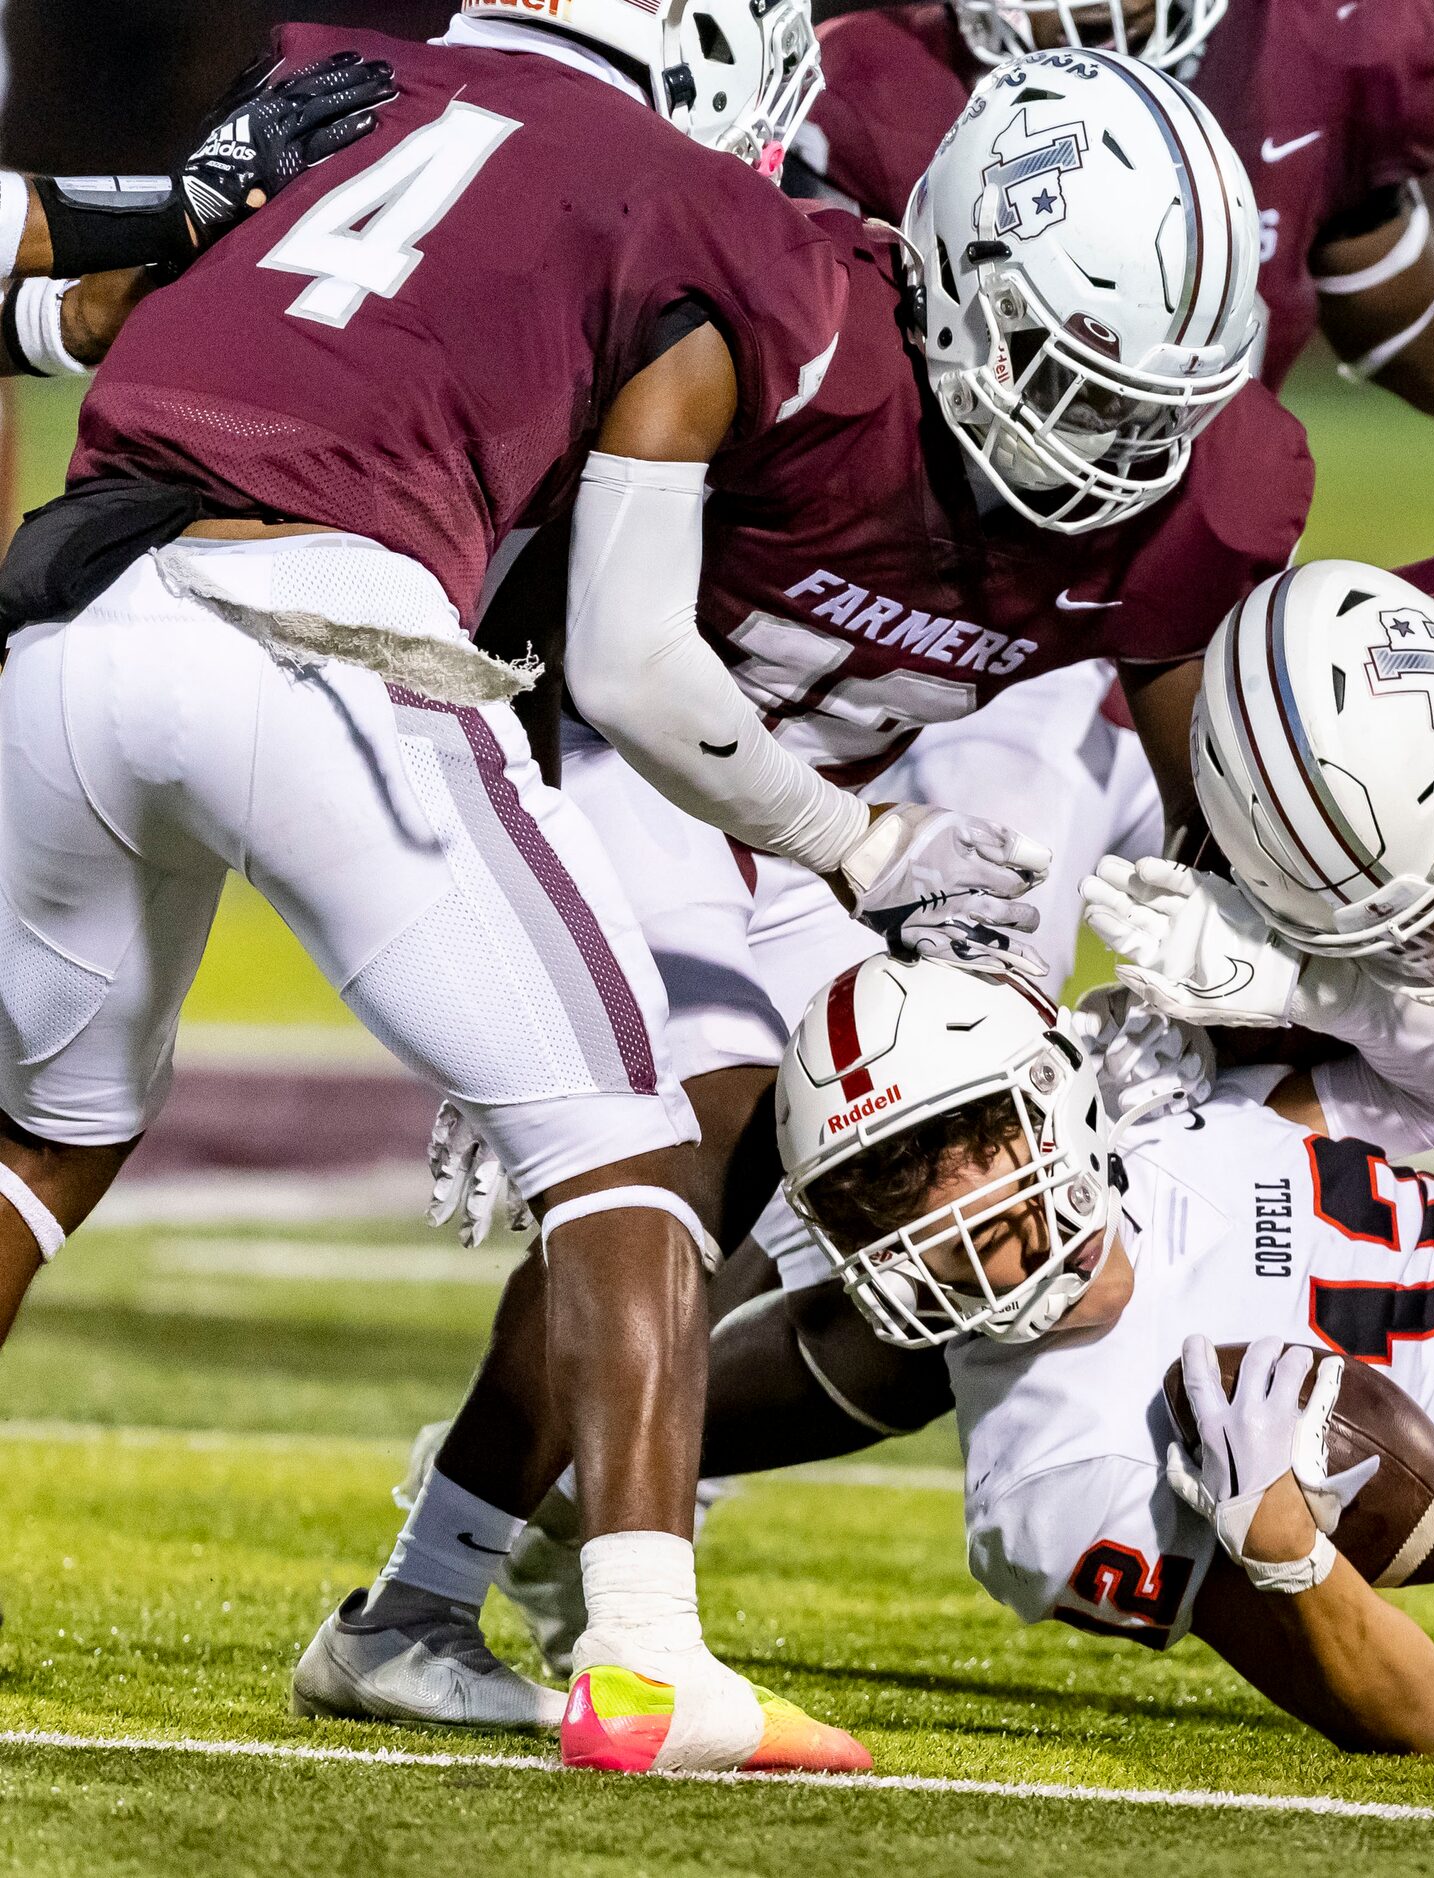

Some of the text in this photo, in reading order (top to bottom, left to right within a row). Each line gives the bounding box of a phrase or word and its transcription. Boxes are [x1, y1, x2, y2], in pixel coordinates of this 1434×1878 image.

[256, 100, 524, 329] 4
[783, 569, 1038, 675] FARMERS
[828, 1084, 902, 1134] Riddell
[1255, 1179, 1291, 1277] COPPELL
